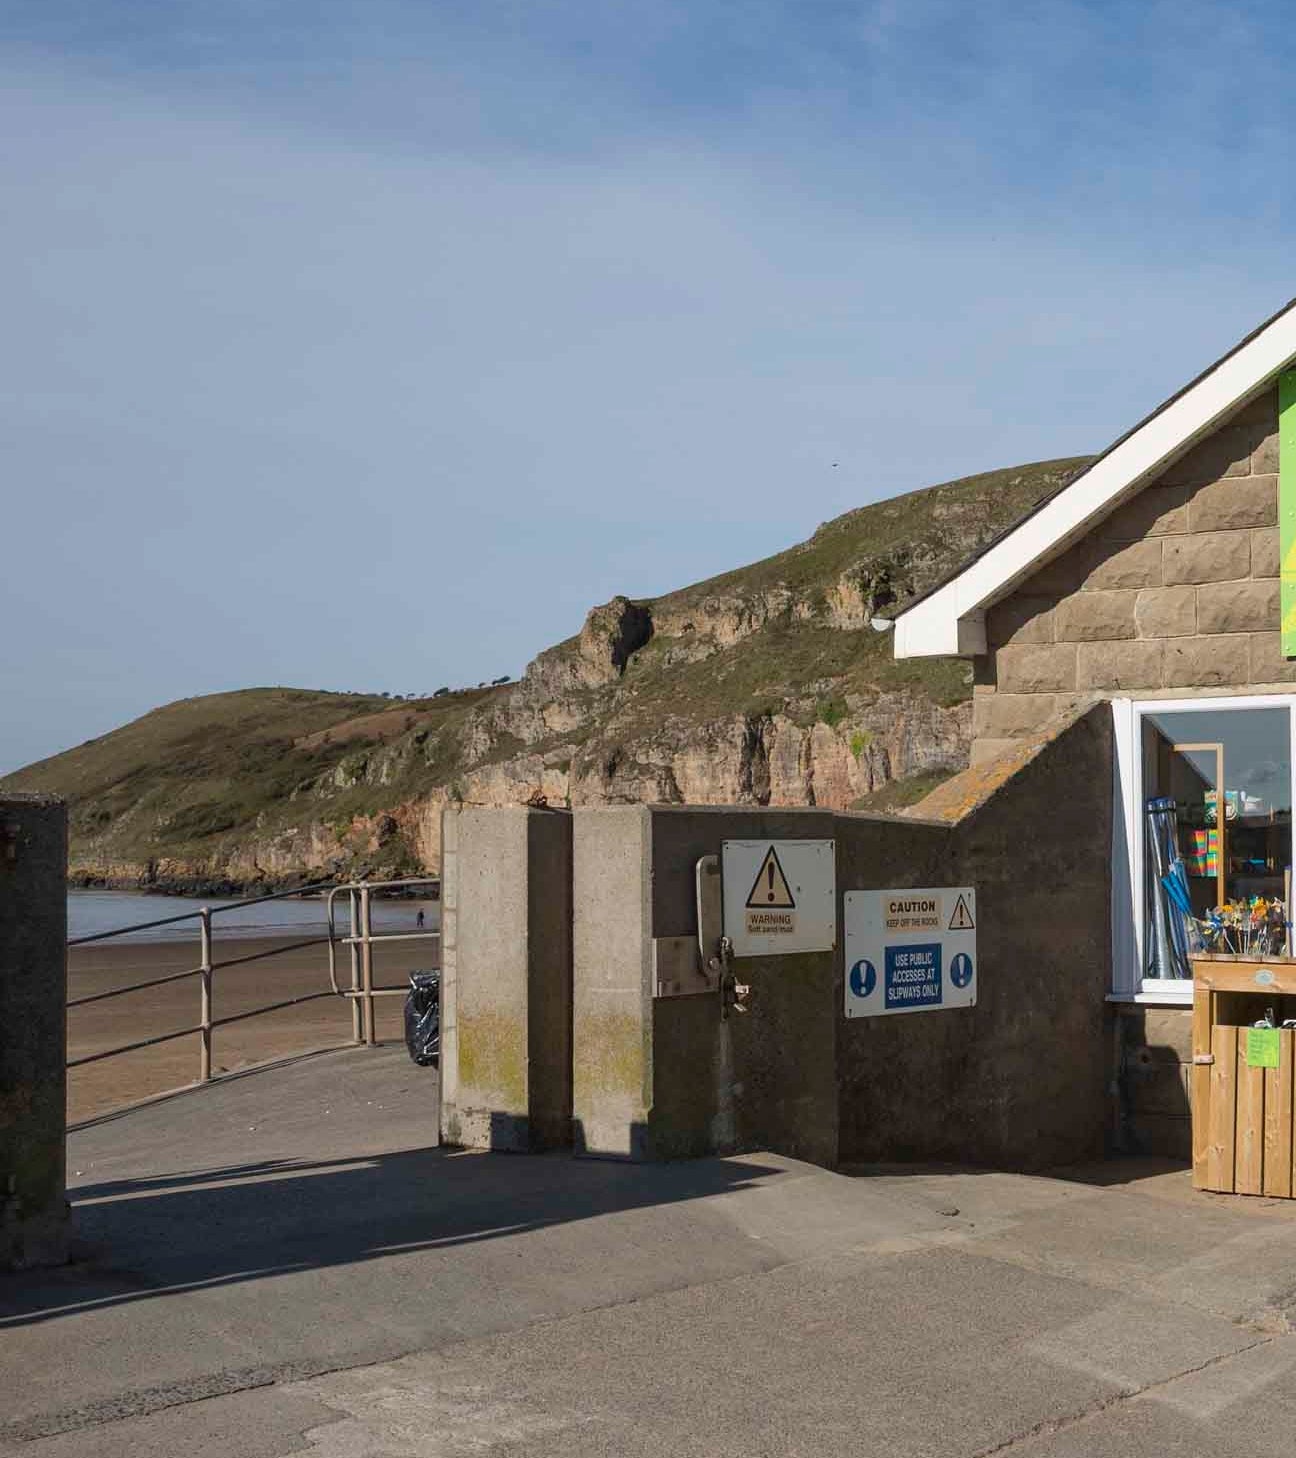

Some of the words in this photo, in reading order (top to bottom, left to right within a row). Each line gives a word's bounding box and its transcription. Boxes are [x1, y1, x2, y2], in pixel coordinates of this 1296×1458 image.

[890, 901, 936, 914] CAUTION
[750, 914, 791, 925] WARNING
[895, 953, 909, 967] USE
[910, 952, 933, 966] PUBLIC
[892, 969, 926, 983] ACCESSES
[926, 968, 935, 980] AT
[888, 985, 921, 1000] SLIPWAYS
[922, 984, 939, 998] ONLY
